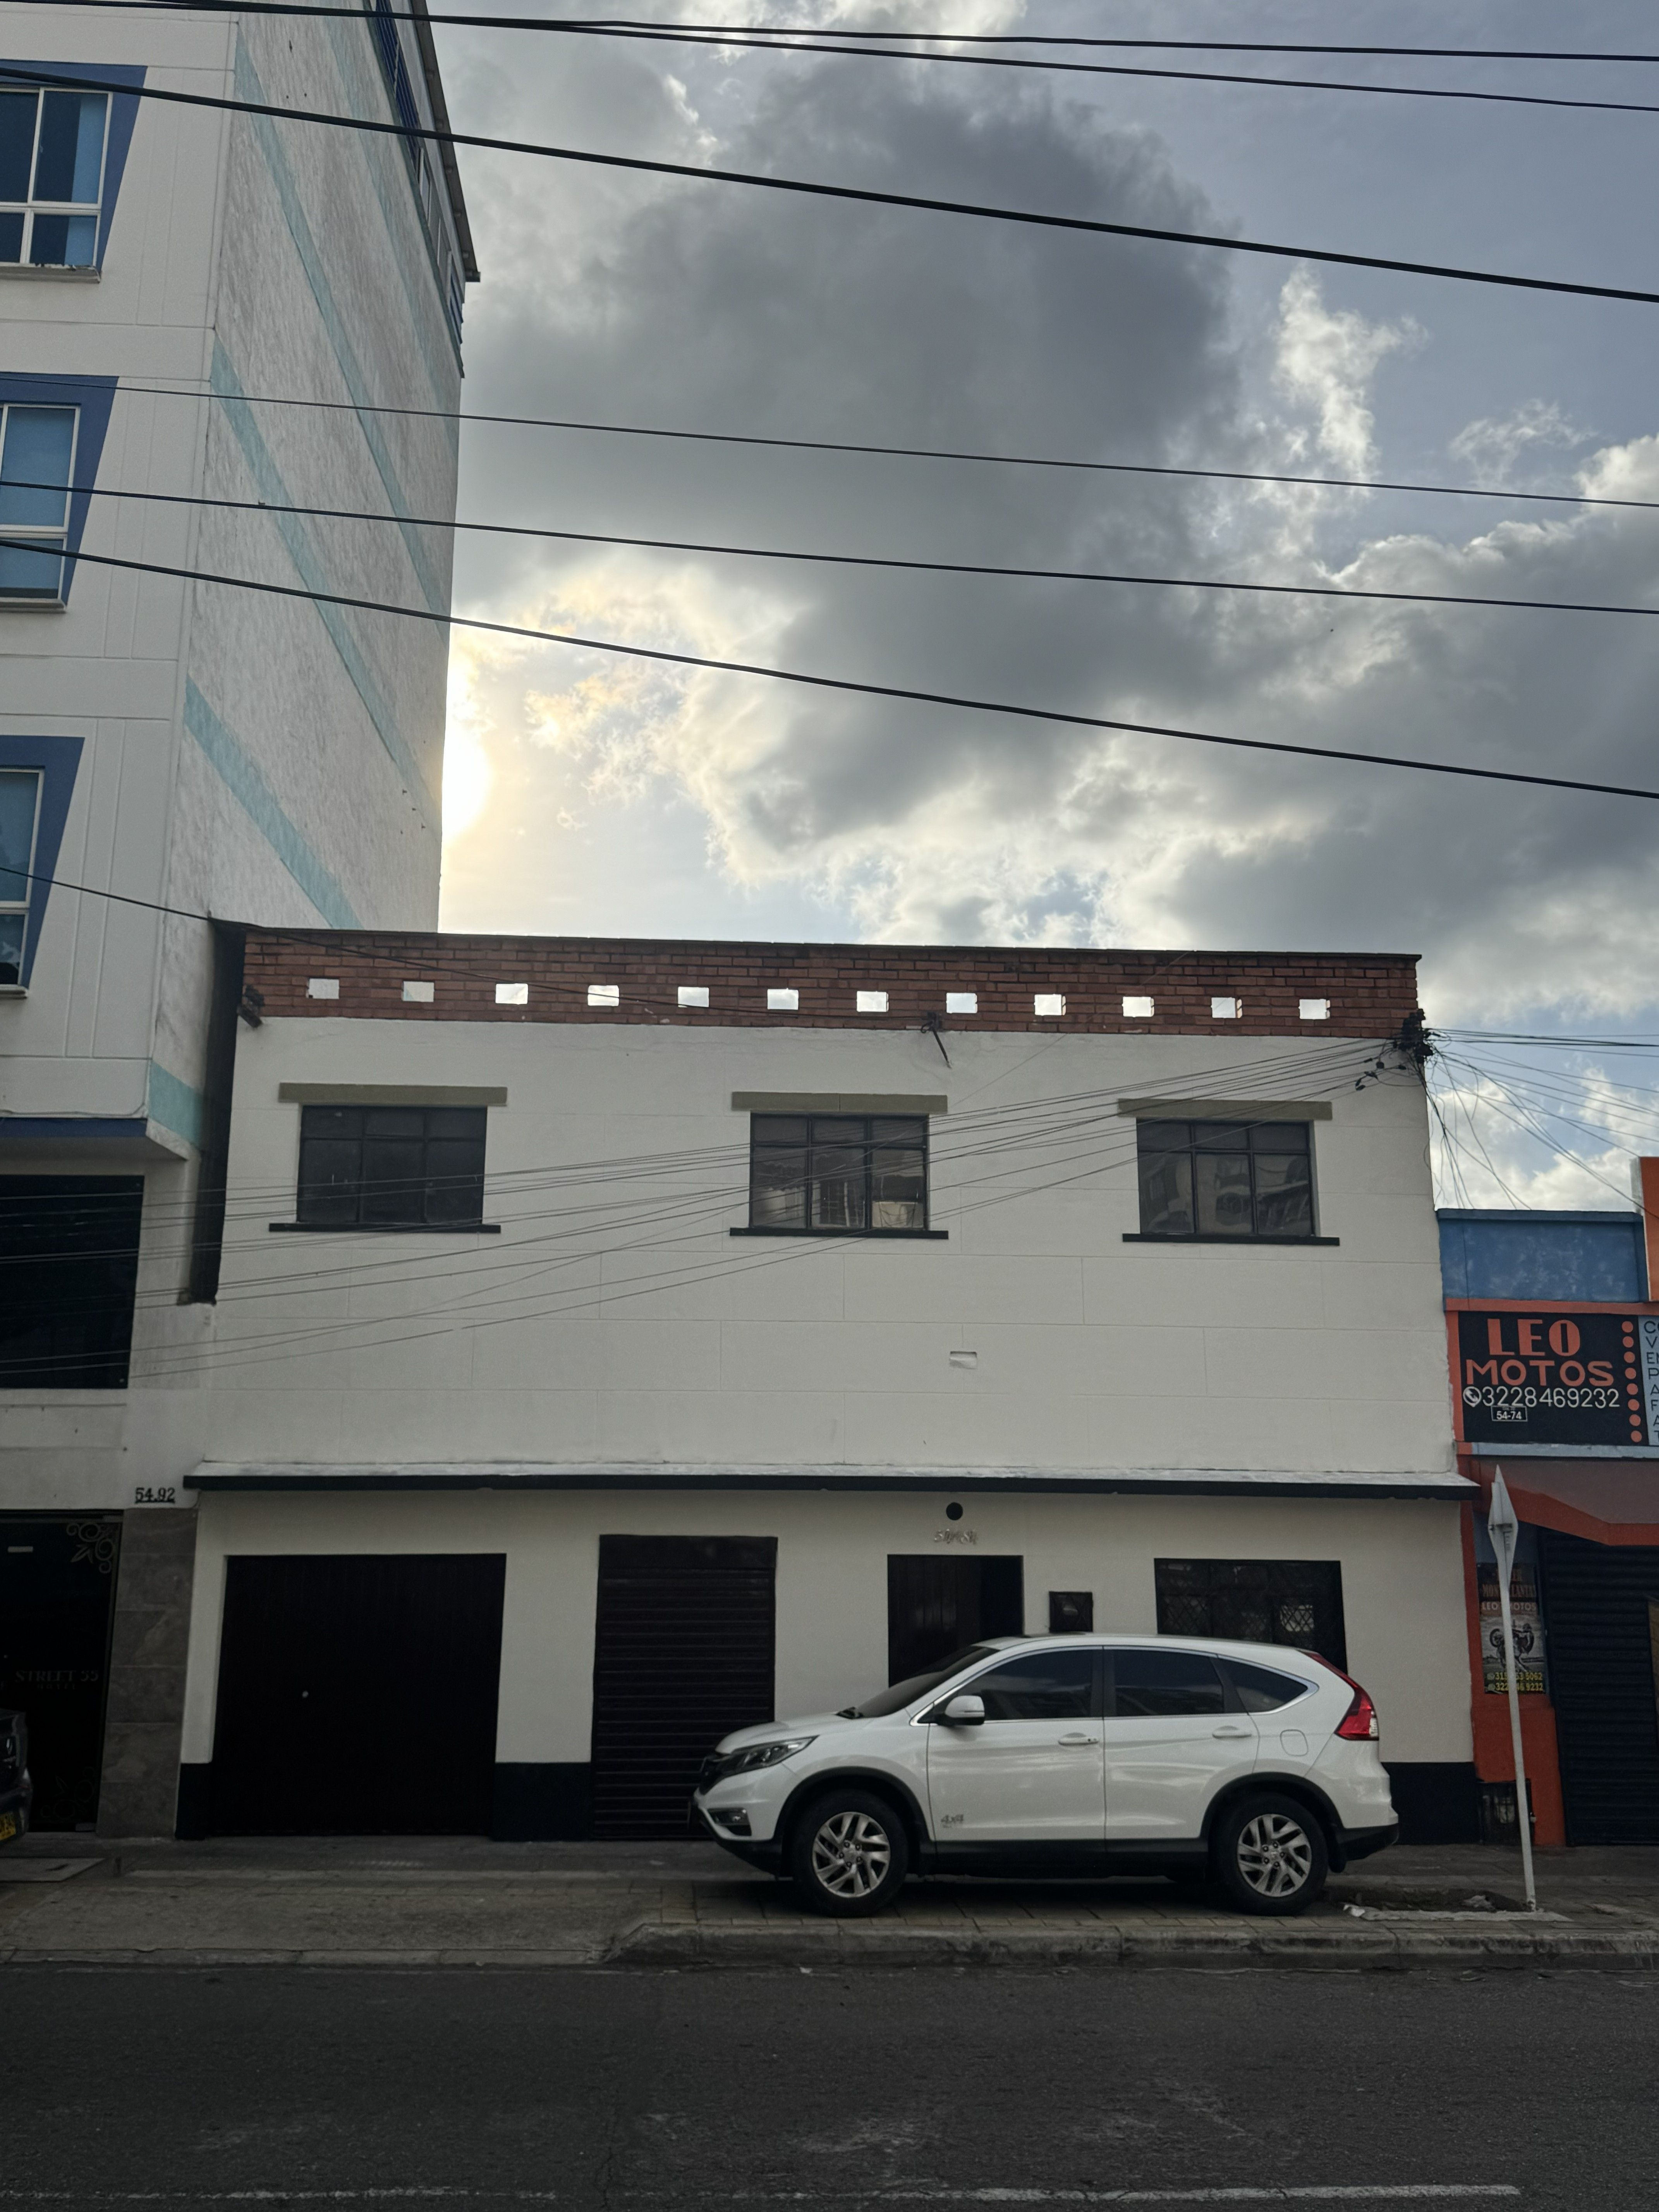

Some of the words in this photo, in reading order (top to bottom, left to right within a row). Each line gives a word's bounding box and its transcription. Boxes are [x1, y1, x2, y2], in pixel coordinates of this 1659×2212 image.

[1487, 1318, 1580, 1356] LEO
[1466, 1359, 1614, 1386] MOTOS
[1482, 1386, 1620, 1409] 3228469232
[1496, 1410, 1522, 1420] 54-74
[1481, 1601, 1498, 1611] LEO
[1509, 1602, 1537, 1611] OTOS
